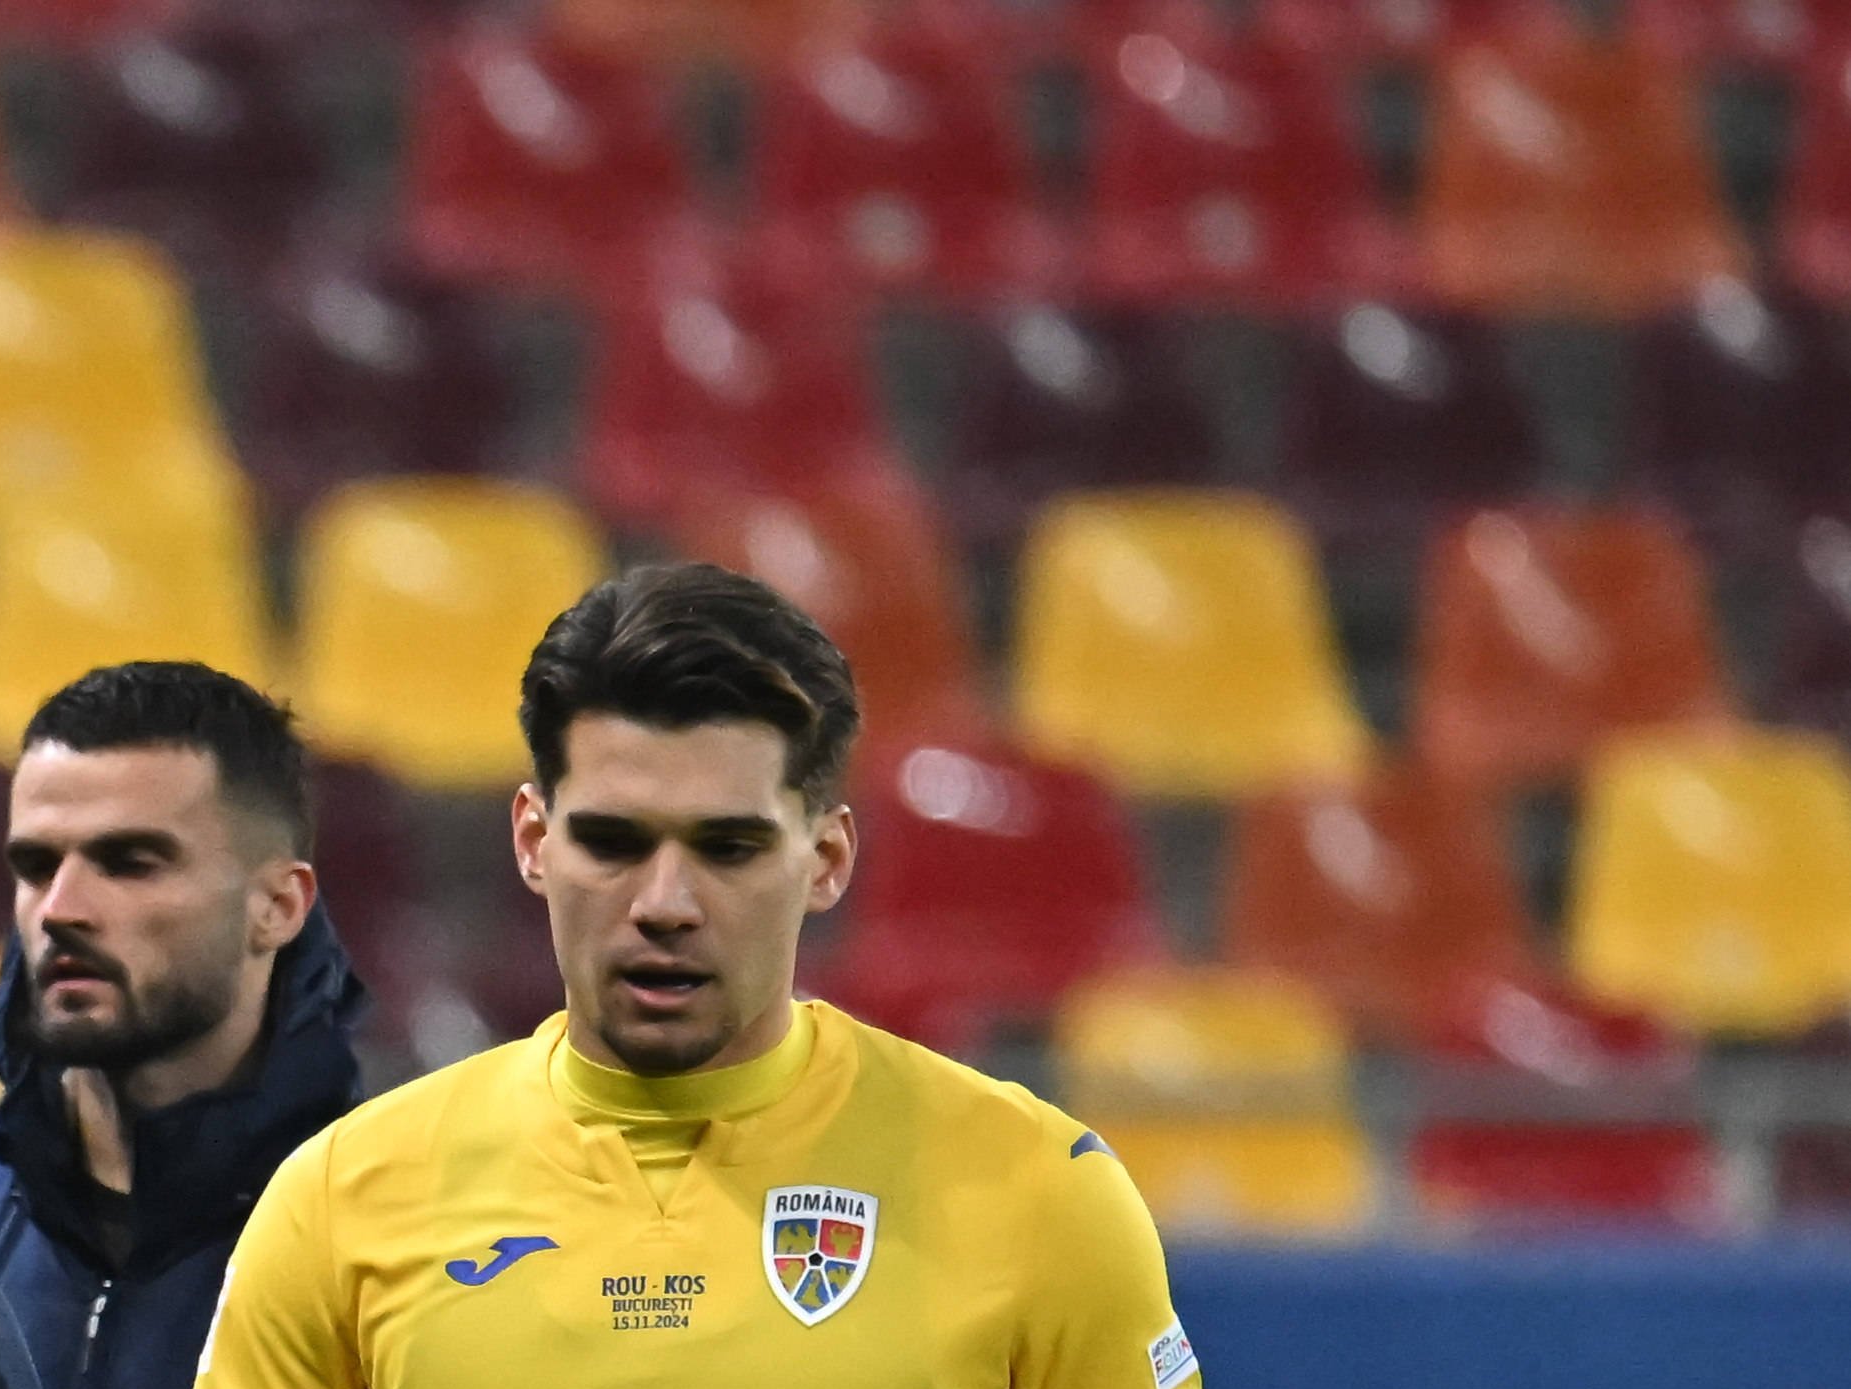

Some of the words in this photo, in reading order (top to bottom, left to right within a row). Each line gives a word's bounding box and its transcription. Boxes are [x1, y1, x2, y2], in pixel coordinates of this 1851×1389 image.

[775, 1190, 866, 1219] ROMÂNIA
[601, 1275, 647, 1297] ROU
[663, 1275, 706, 1295] KOS
[612, 1314, 690, 1330] 15.11.2024
